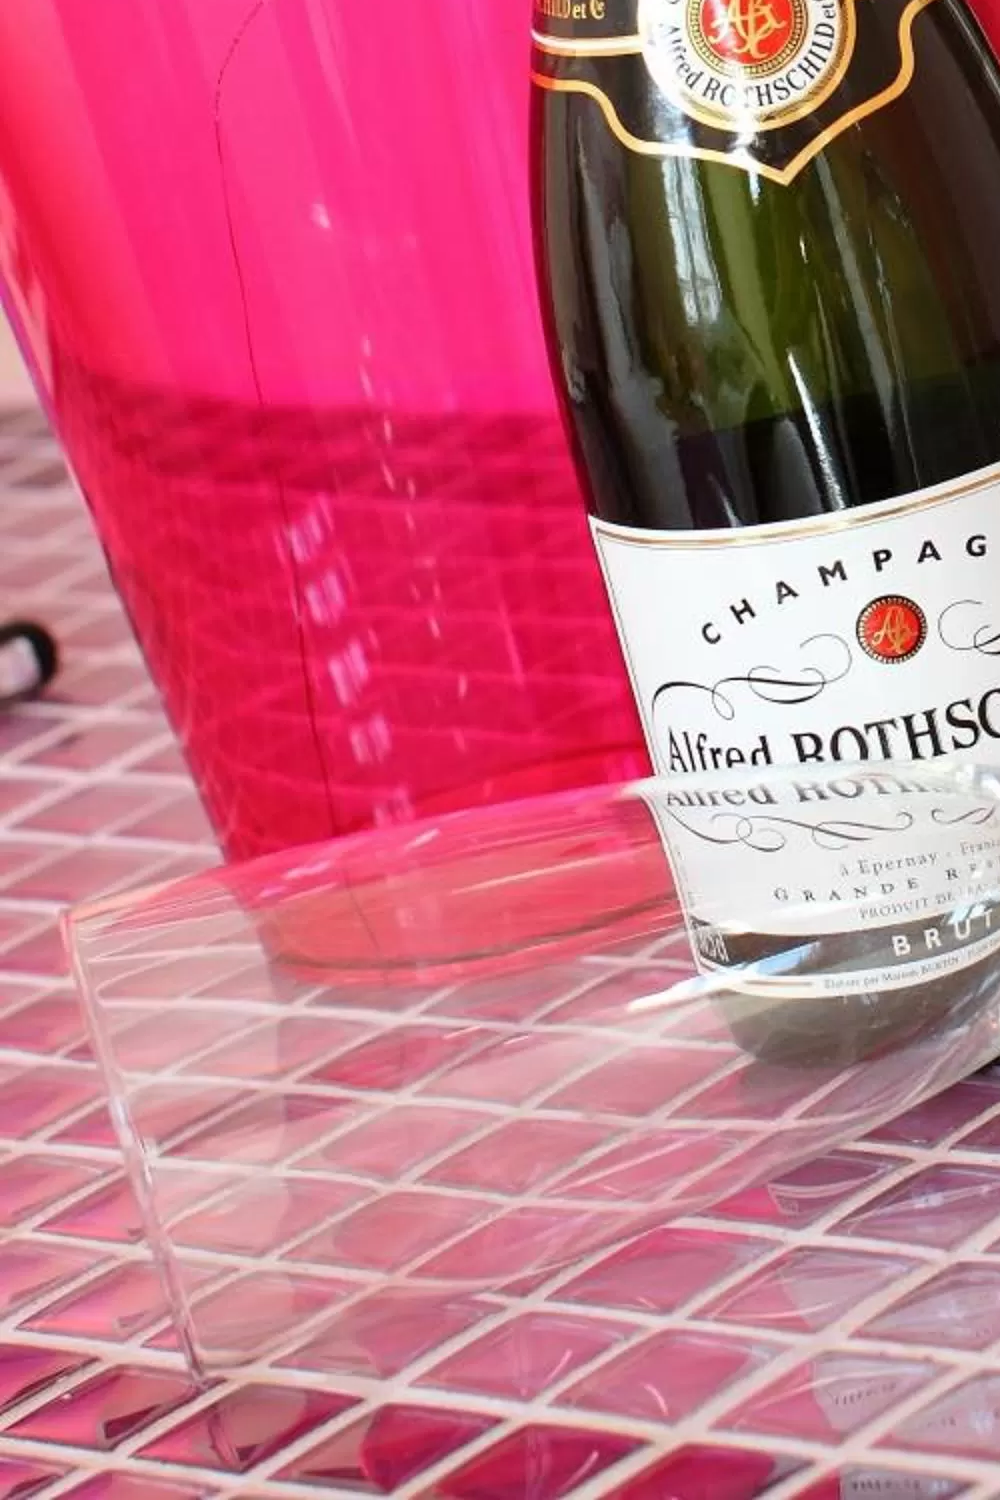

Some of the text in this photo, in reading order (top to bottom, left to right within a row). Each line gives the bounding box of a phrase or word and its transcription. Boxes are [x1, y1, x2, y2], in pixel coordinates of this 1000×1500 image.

[667, 726, 773, 773] Alfred
[773, 877, 920, 902] GRANDE
[891, 908, 993, 957] BRUT
